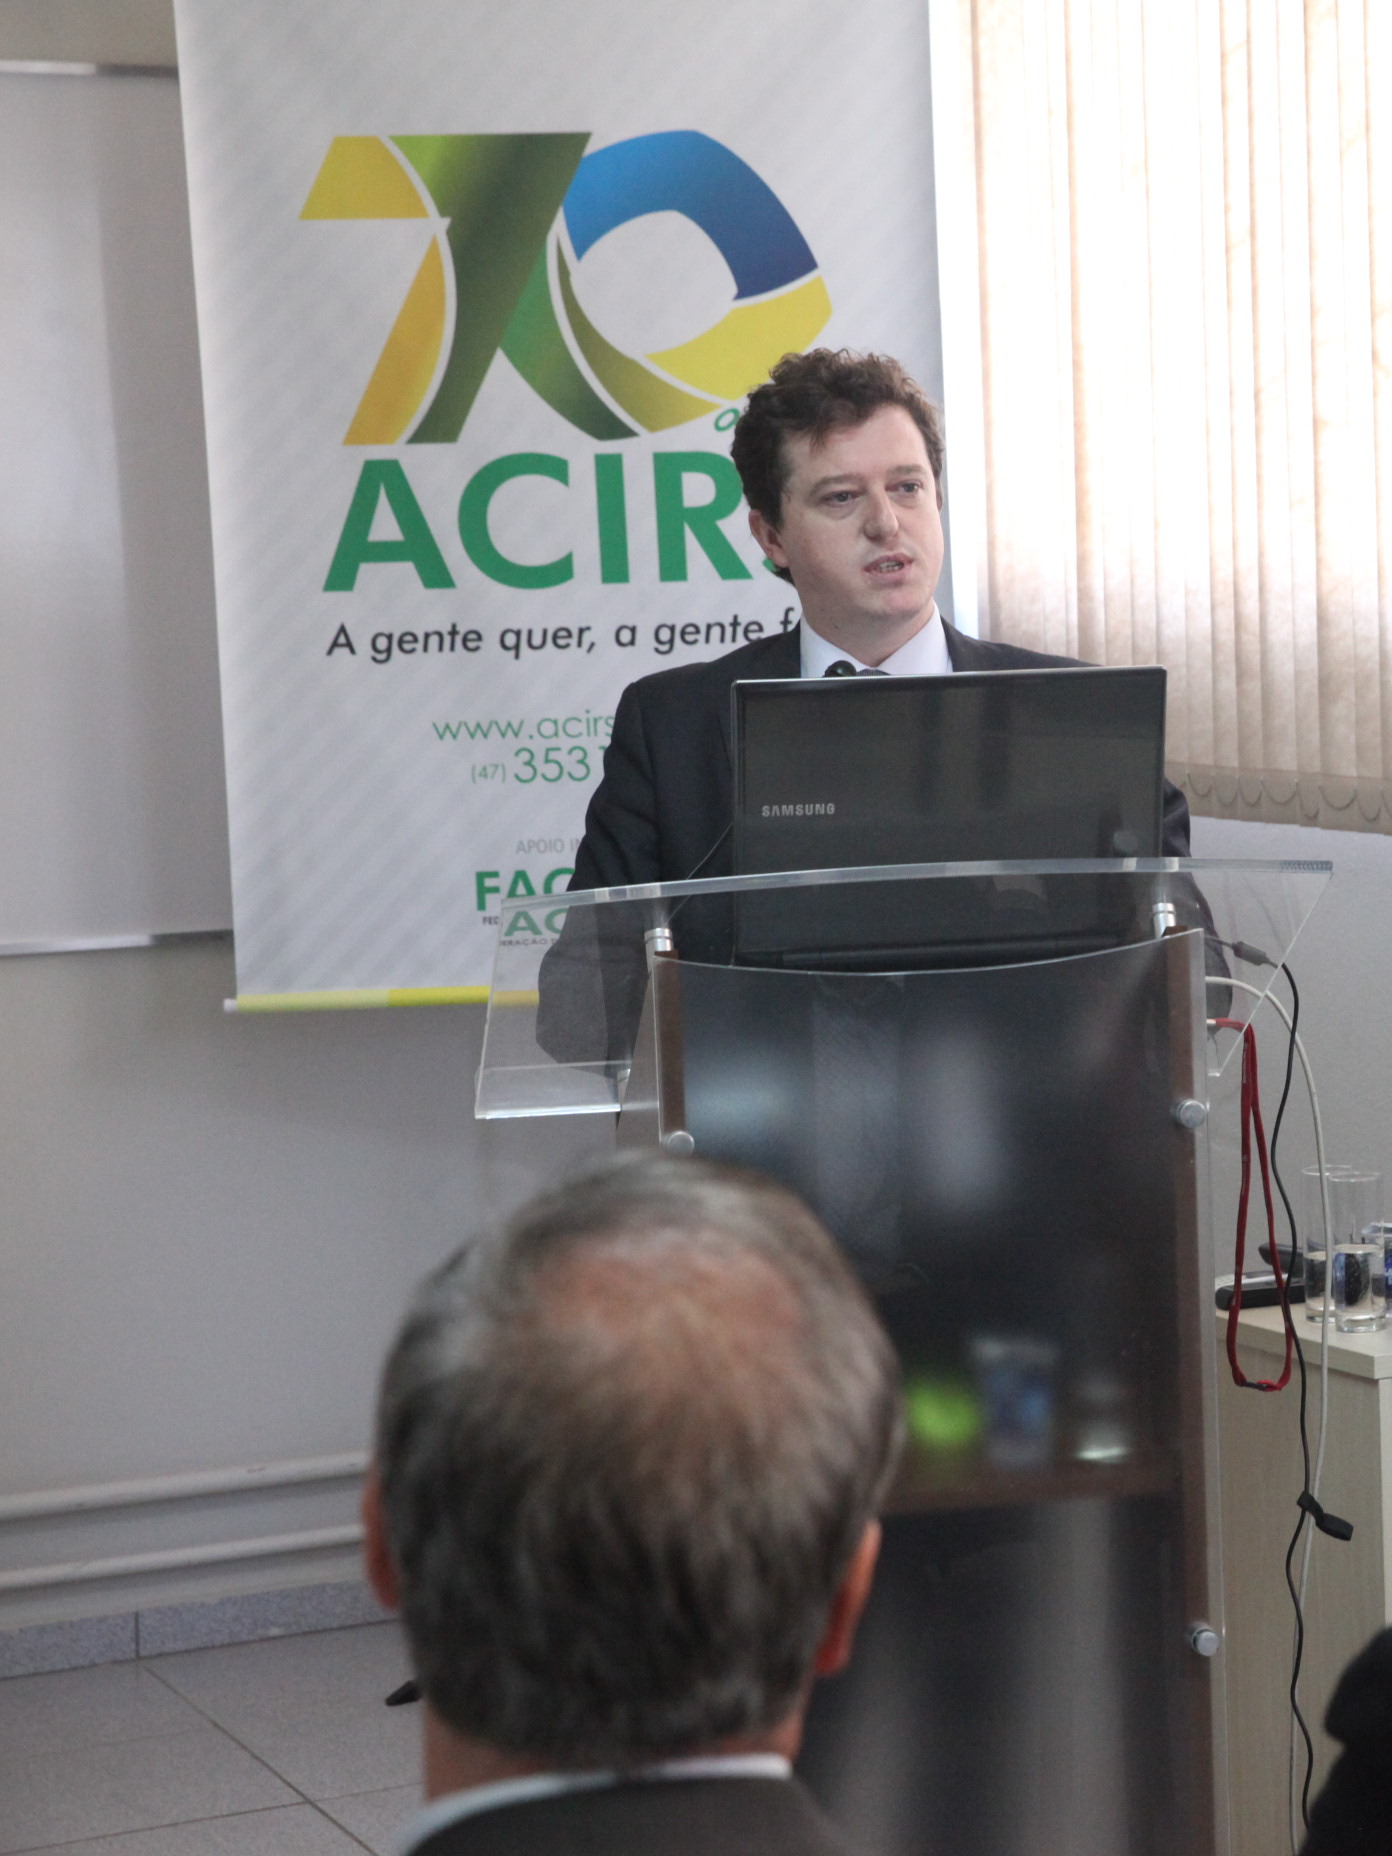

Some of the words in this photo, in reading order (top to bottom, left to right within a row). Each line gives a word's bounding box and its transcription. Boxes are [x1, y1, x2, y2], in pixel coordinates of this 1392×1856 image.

[322, 451, 776, 592] ACIR
[326, 623, 356, 656] A
[371, 623, 483, 664] gente
[500, 626, 597, 660] quer,
[615, 624, 636, 647] a
[653, 614, 764, 655] gente
[471, 763, 506, 784] (47)
[514, 745, 607, 783] 353
[762, 803, 835, 817] SAMSUNG
[515, 839, 564, 854] APOIO
